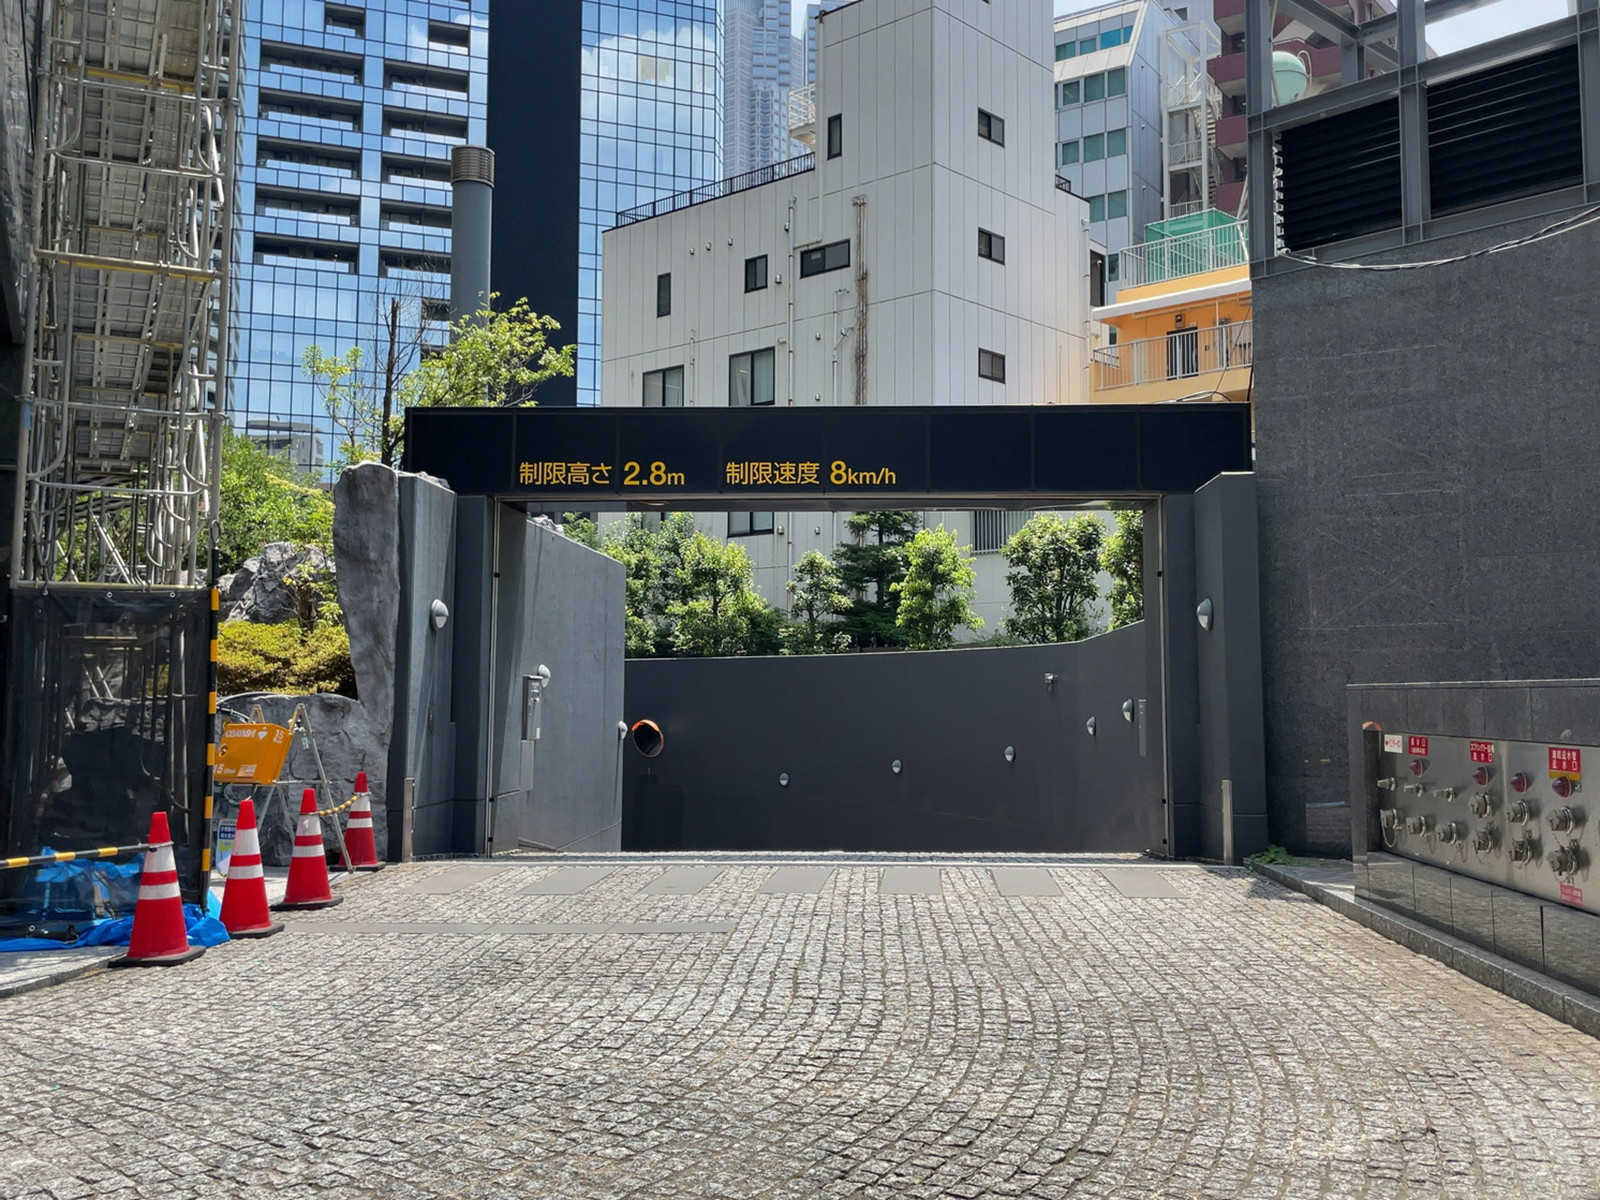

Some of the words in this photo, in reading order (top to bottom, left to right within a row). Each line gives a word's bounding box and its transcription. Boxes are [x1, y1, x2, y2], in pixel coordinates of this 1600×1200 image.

[519, 461, 612, 485] 制限高さ
[623, 461, 685, 486] 2.8m
[726, 461, 820, 485] 制限速度
[830, 460, 896, 485] 8km/h
